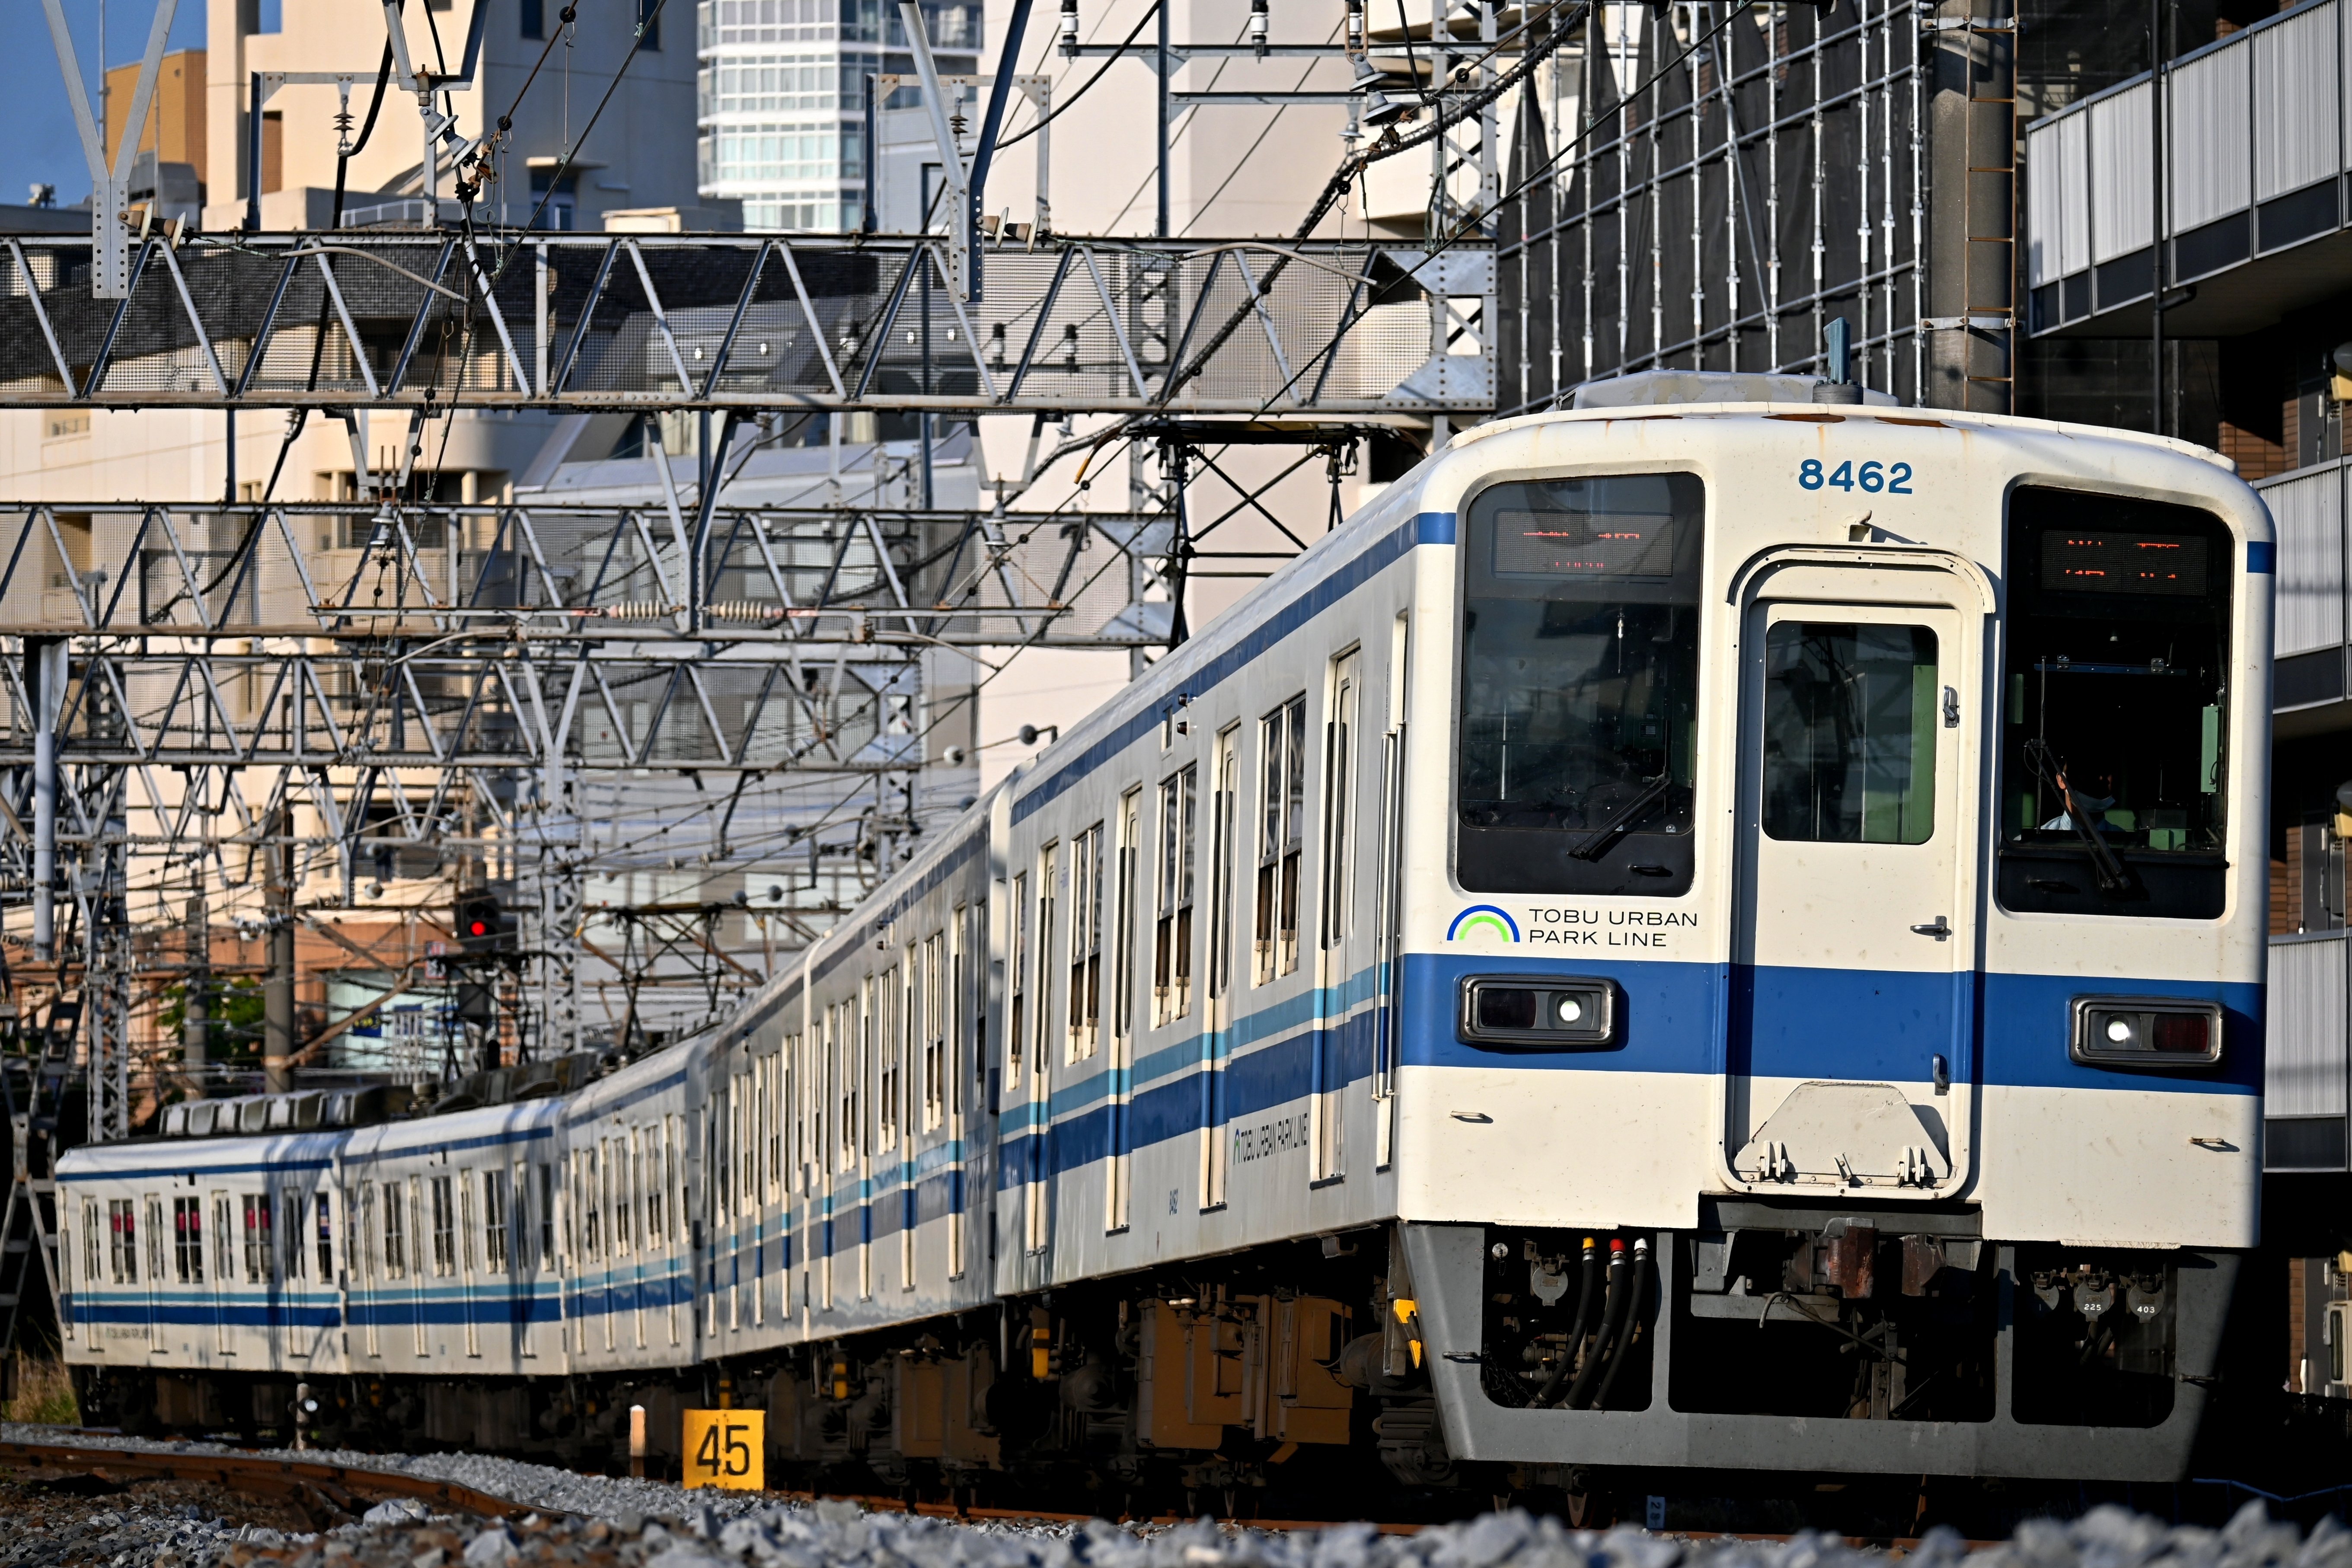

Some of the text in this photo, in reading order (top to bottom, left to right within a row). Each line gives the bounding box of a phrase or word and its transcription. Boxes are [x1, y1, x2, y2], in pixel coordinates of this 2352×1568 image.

[1799, 459, 1913, 494] 8462
[1529, 909, 1698, 926] TOBU URBAN
[1529, 929, 1667, 947] PARK LINE
[1241, 1112, 1308, 1162] TOBU URBAN PARK LINE
[696, 1425, 750, 1476] 45
